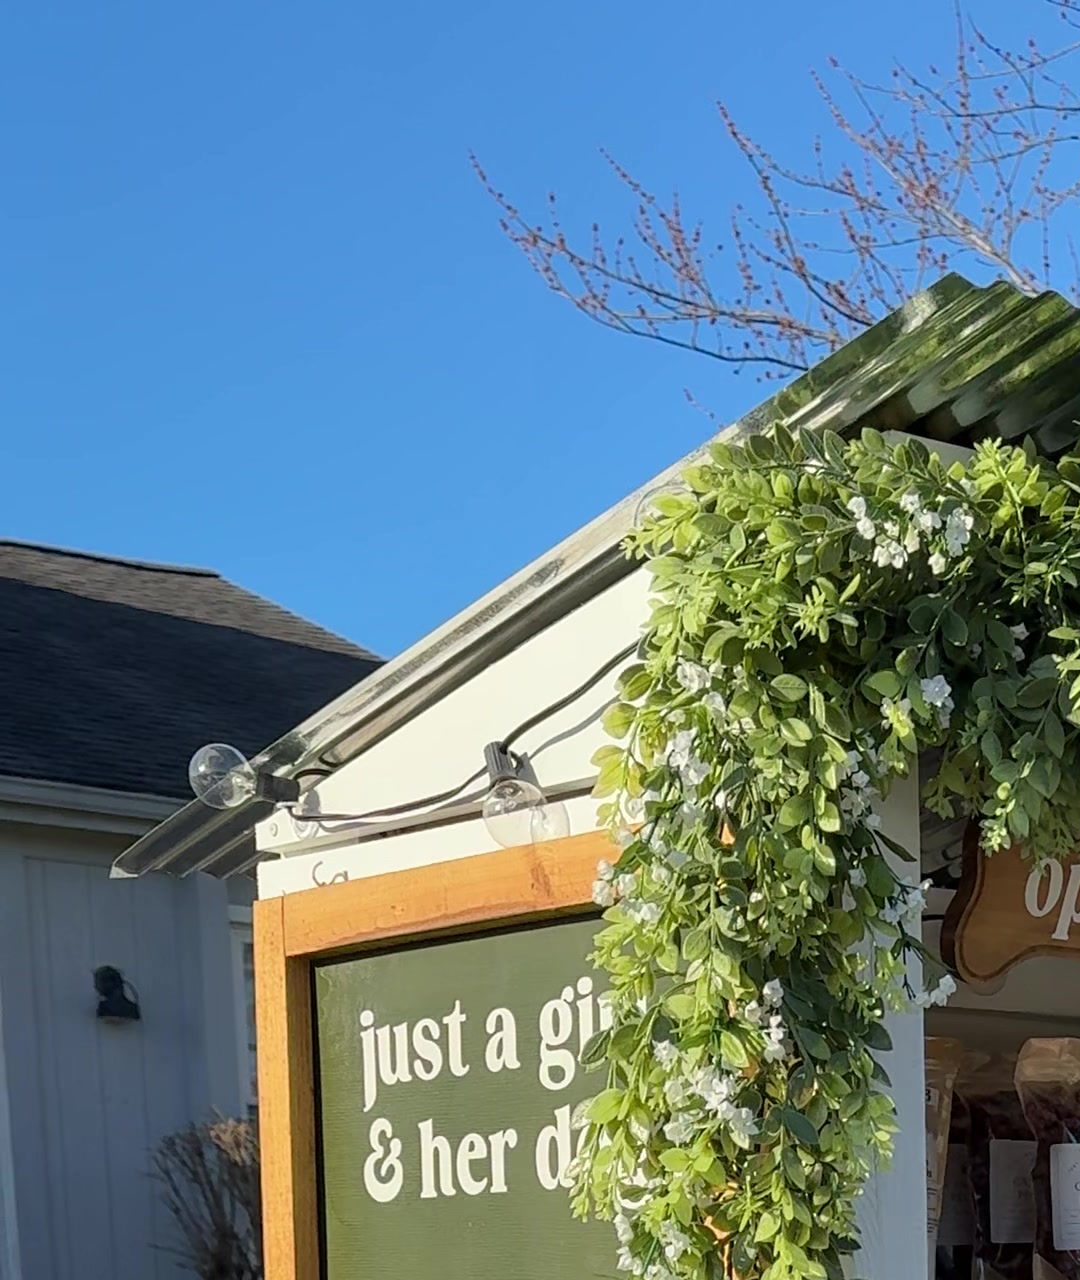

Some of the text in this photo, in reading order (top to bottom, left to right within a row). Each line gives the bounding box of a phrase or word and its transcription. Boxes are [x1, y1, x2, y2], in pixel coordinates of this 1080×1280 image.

[359, 1000, 470, 1113] just
[485, 1007, 521, 1073] a
[363, 1117, 404, 1203] &
[417, 1118, 518, 1198] her
